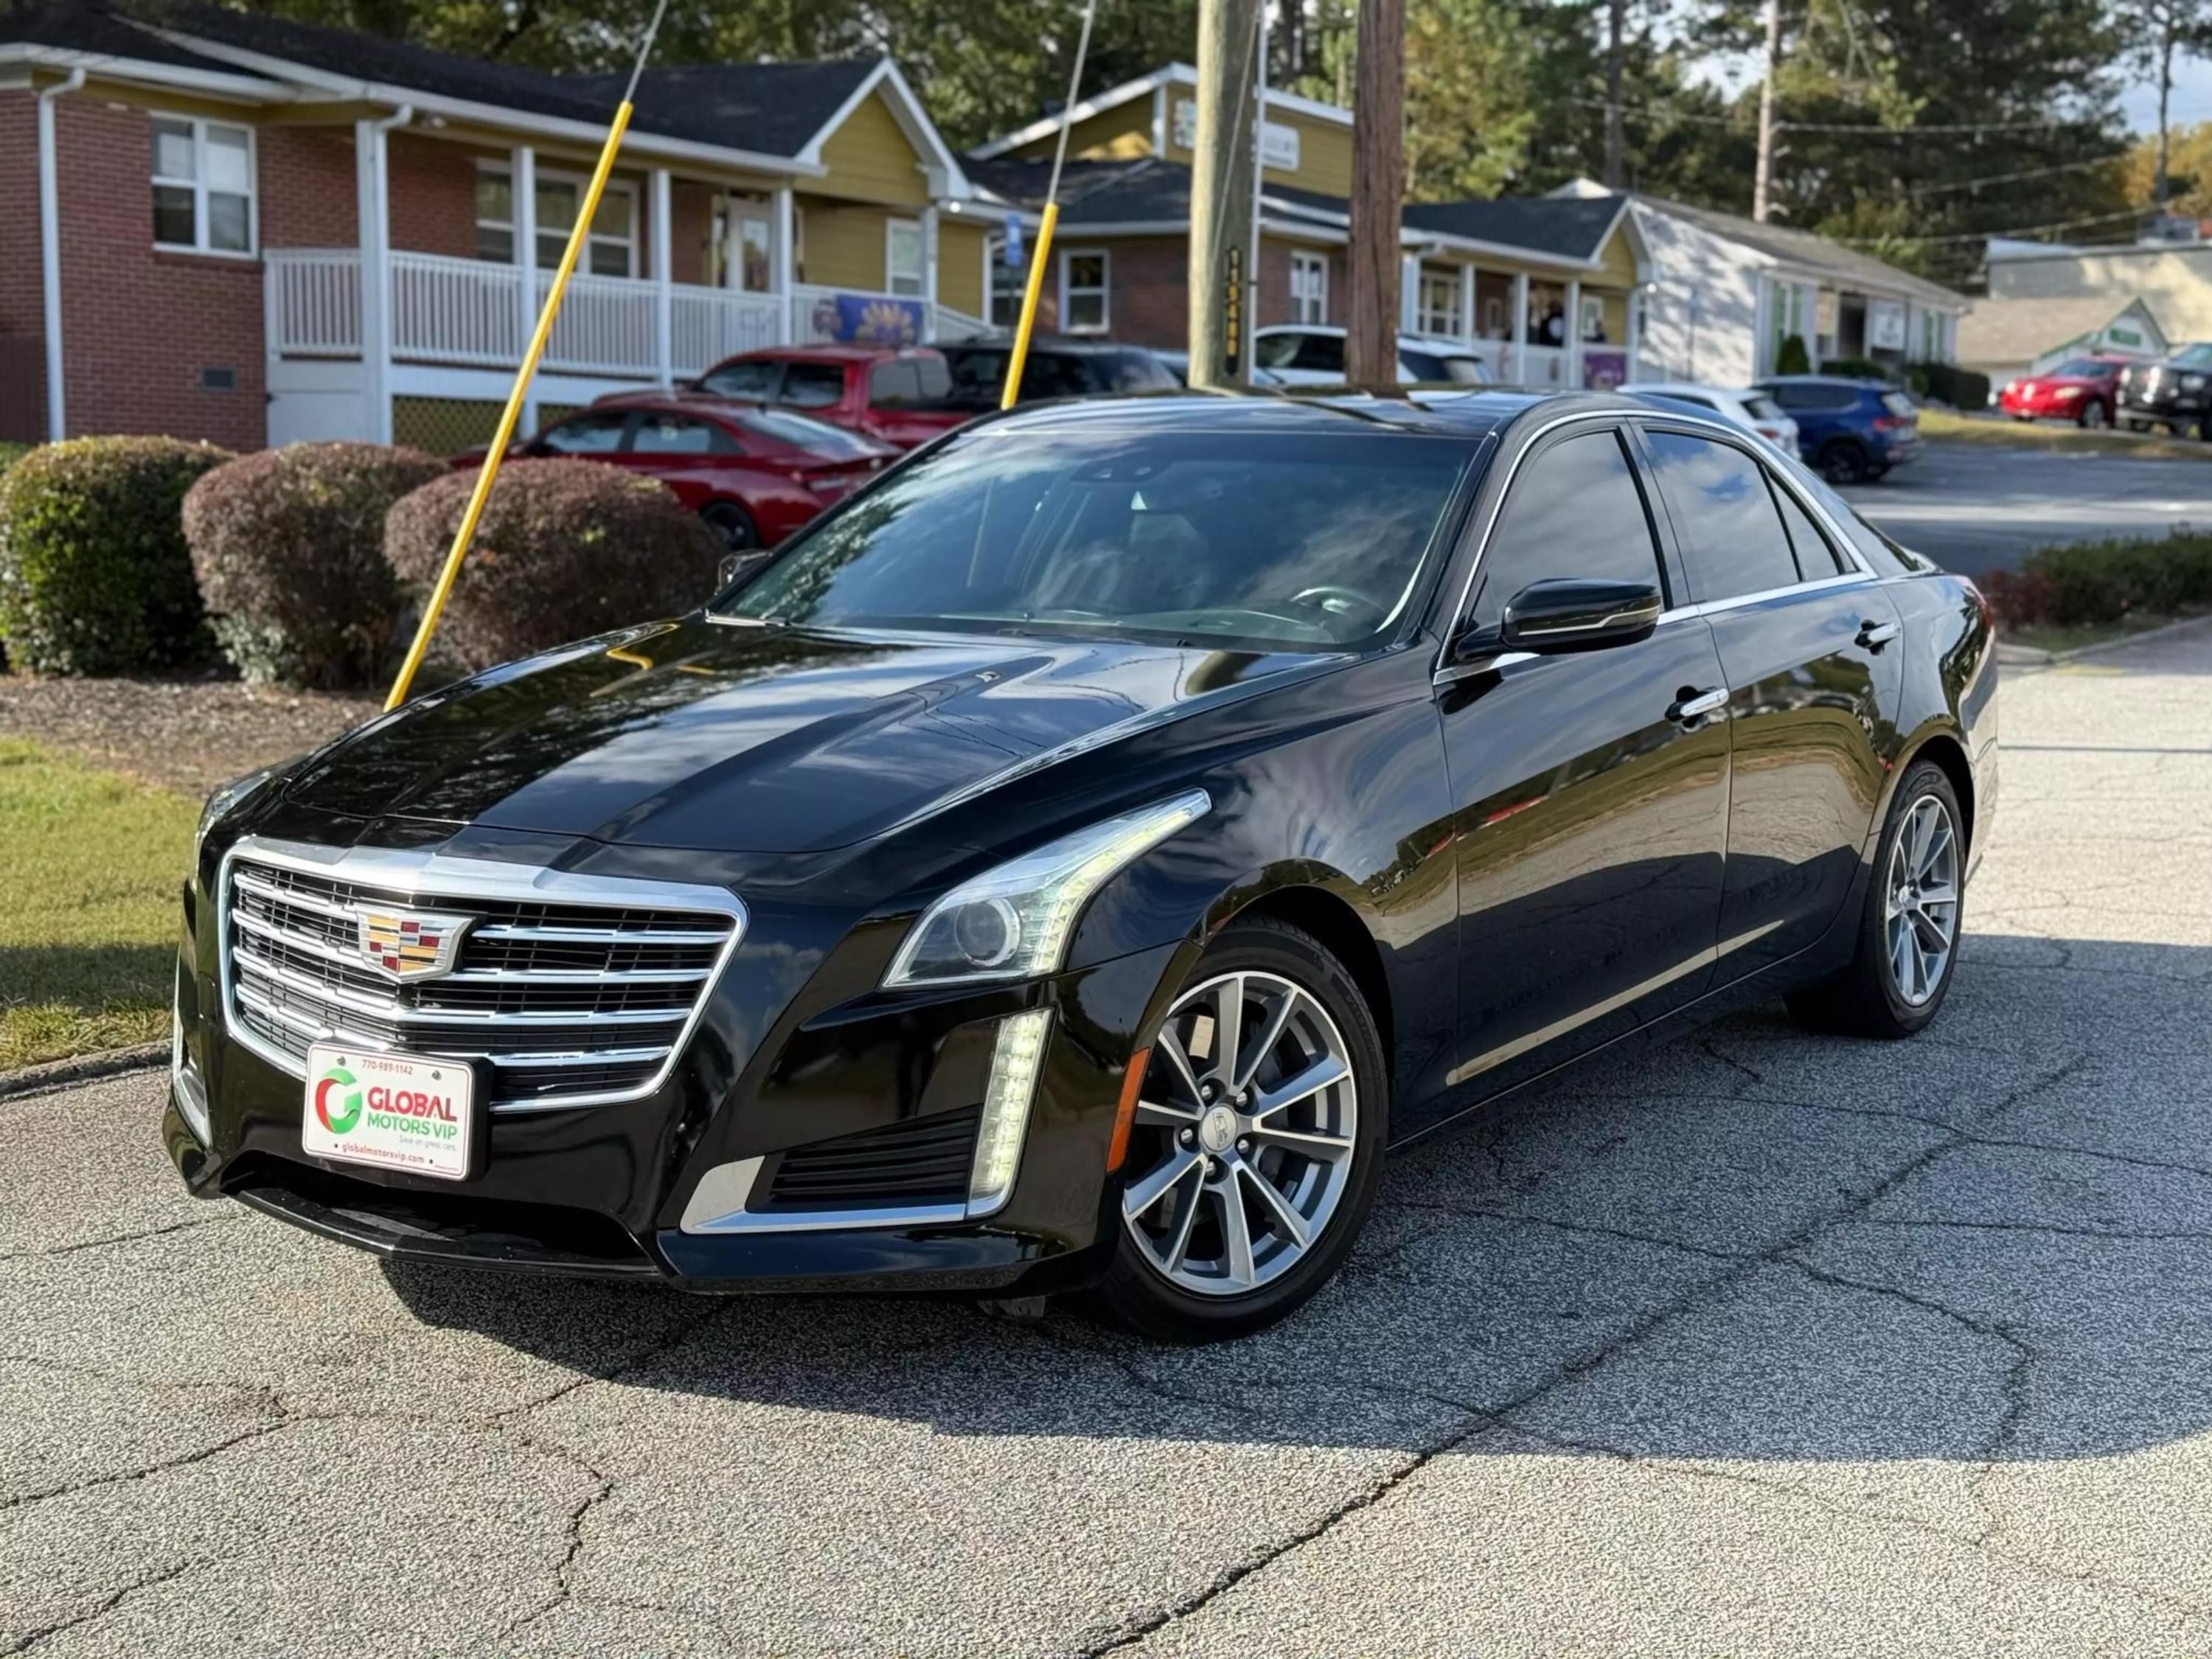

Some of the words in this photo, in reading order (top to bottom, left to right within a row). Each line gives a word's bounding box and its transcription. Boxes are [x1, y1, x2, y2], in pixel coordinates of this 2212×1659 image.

[367, 1087, 457, 1122] GLOBAL
[367, 1113, 431, 1135] MOTORS
[432, 1124, 458, 1139] VIP
[342, 1142, 425, 1164] globalmotorsvip.com
